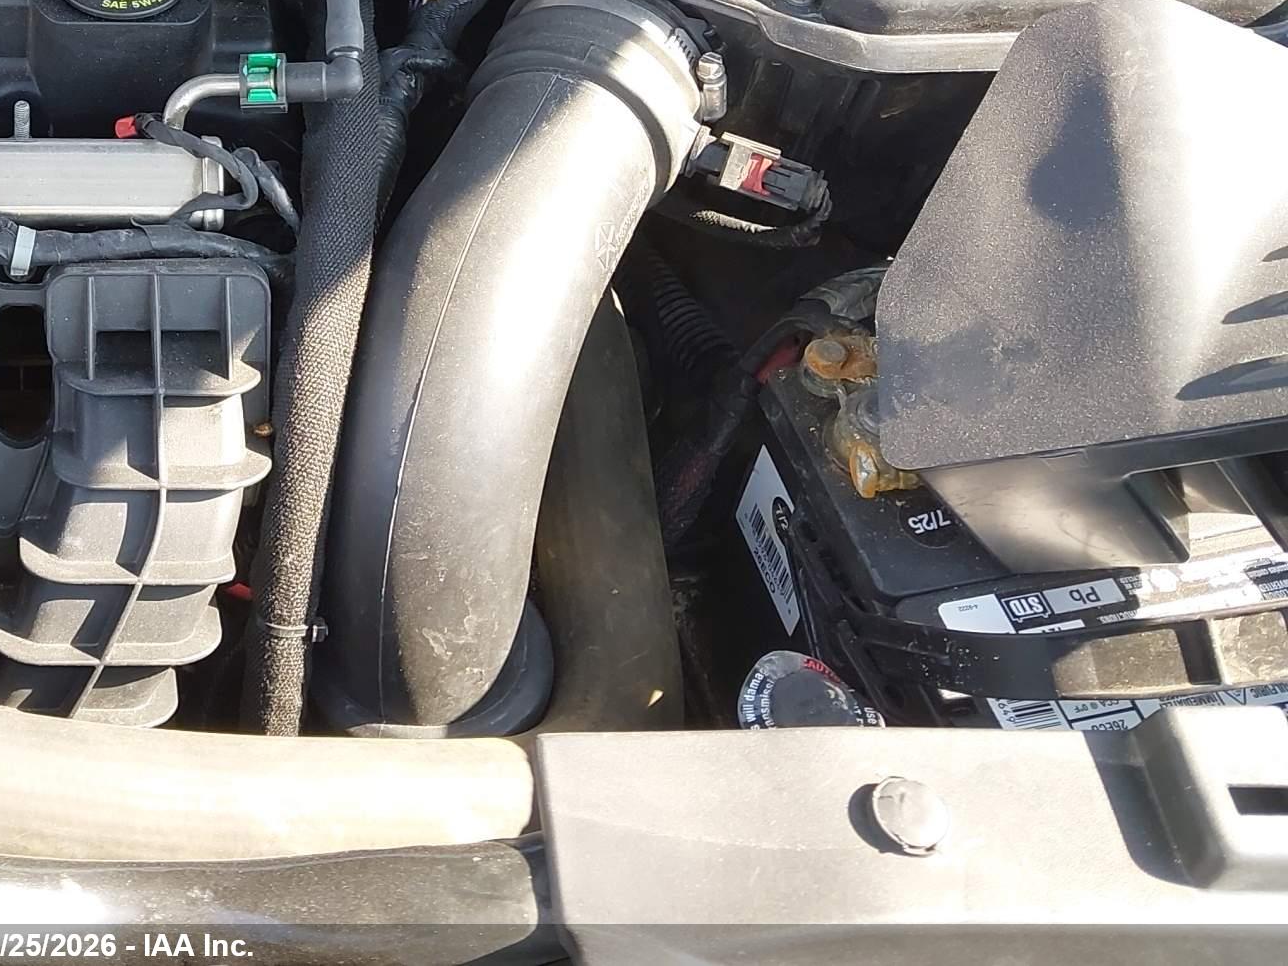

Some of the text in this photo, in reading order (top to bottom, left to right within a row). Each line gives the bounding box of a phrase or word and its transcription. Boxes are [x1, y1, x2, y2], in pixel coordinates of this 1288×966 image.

[908, 507, 951, 536] 7/25
[1067, 585, 1099, 604] Pb
[1009, 595, 1045, 619] STD
[745, 705, 757, 723] will
